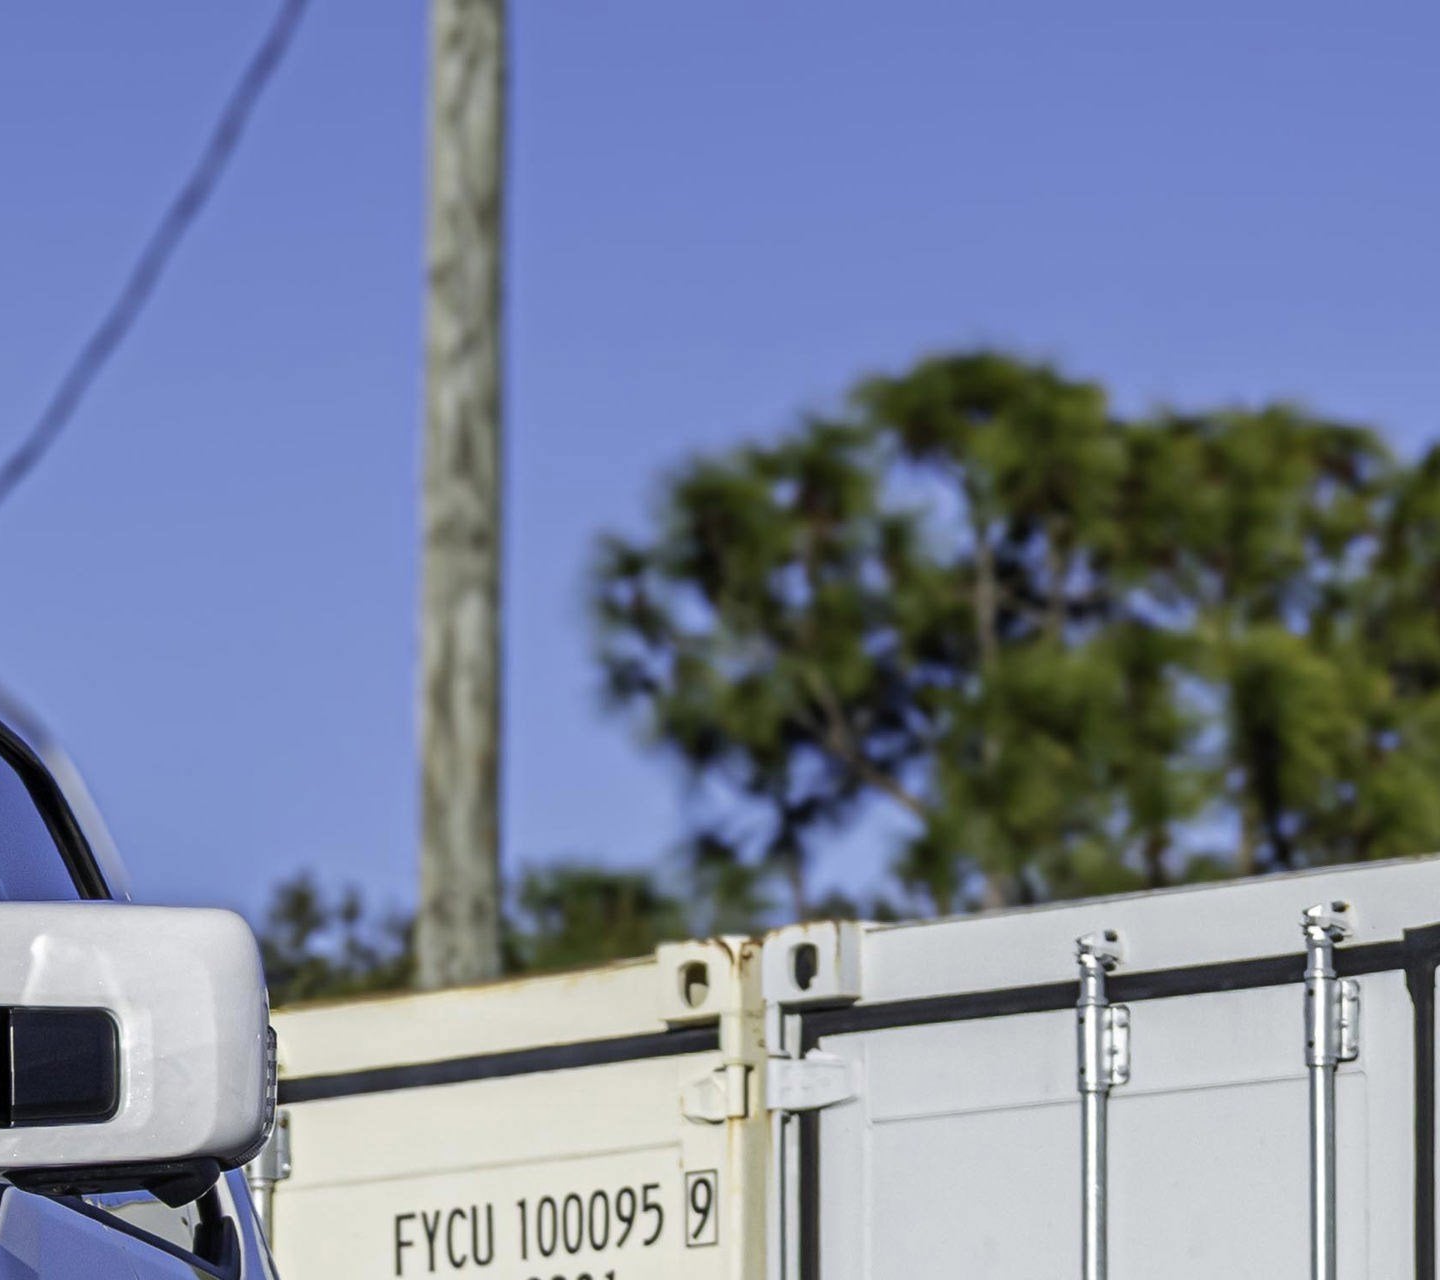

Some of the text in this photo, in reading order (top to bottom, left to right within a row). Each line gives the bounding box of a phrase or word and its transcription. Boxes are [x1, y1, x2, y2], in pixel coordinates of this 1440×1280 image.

[394, 1177, 713, 1277] FYCU 100095 9
